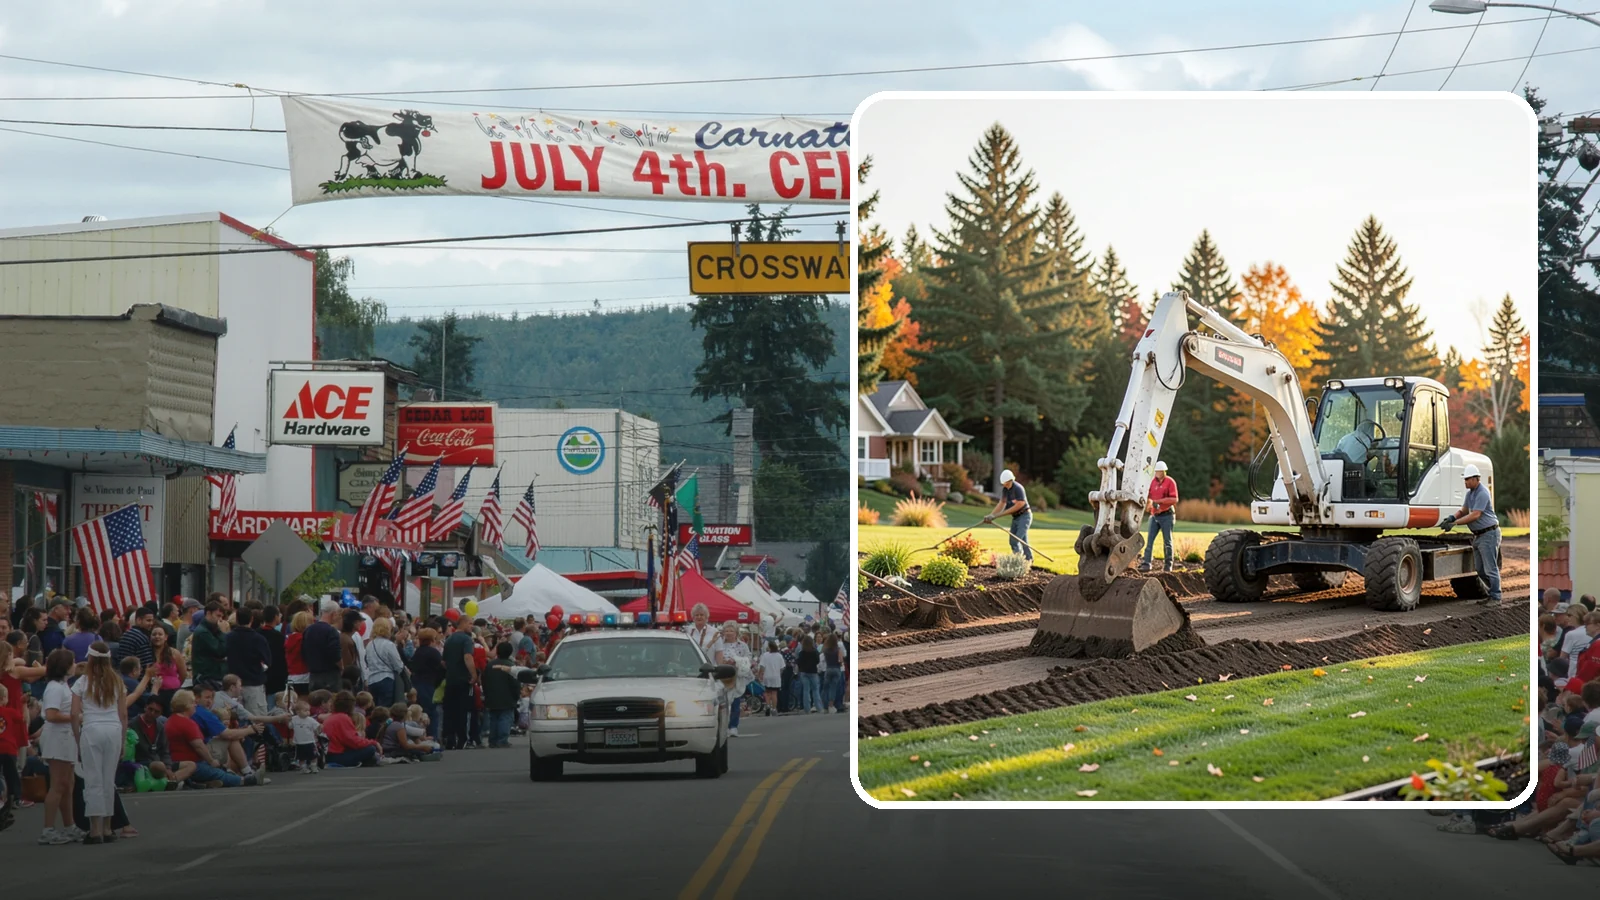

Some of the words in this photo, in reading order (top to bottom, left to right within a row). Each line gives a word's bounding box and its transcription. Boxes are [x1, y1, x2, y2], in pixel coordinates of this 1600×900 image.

[481, 141, 605, 193] JULY
[632, 150, 746, 198] 4th.
[697, 254, 850, 280] CROSSWA
[283, 380, 373, 420] ACE
[406, 409, 452, 422] CEDAR
[461, 409, 485, 422] LOG
[283, 421, 371, 436] Hardware
[417, 428, 476, 446] Coca-Cola
[95, 485, 124, 495] Vincent
[126, 486, 135, 495] de
[137, 486, 155, 495] Paul
[688, 526, 741, 535] CRNATION
[699, 535, 730, 543] GLASS
